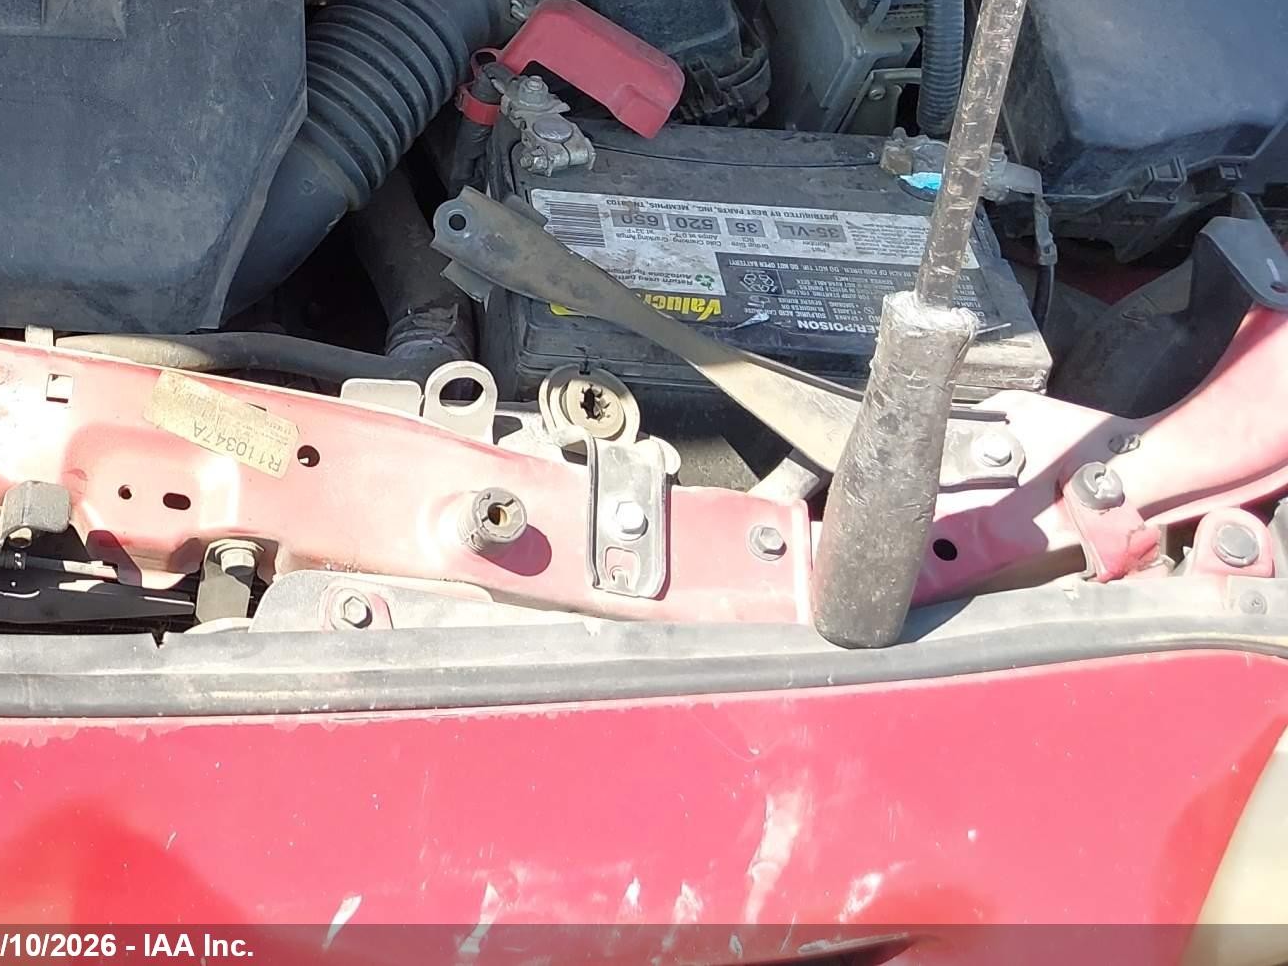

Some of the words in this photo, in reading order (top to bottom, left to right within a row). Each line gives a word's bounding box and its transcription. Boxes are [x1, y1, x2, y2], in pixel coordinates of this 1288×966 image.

[647, 201, 689, 211] MEMPHIS,
[714, 206, 744, 214] PARTS,
[621, 214, 659, 227] 650
[783, 211, 838, 221] DISTRIBUTED
[675, 217, 713, 230] 520
[735, 222, 757, 234] 35
[783, 225, 840, 239] 35-VL
[637, 234, 668, 243] Cranking
[673, 237, 704, 245] Cranking
[759, 261, 774, 269] OPEN
[648, 271, 692, 279] AutoZone
[662, 278, 693, 286] Return
[193, 420, 282, 472] R110347A
